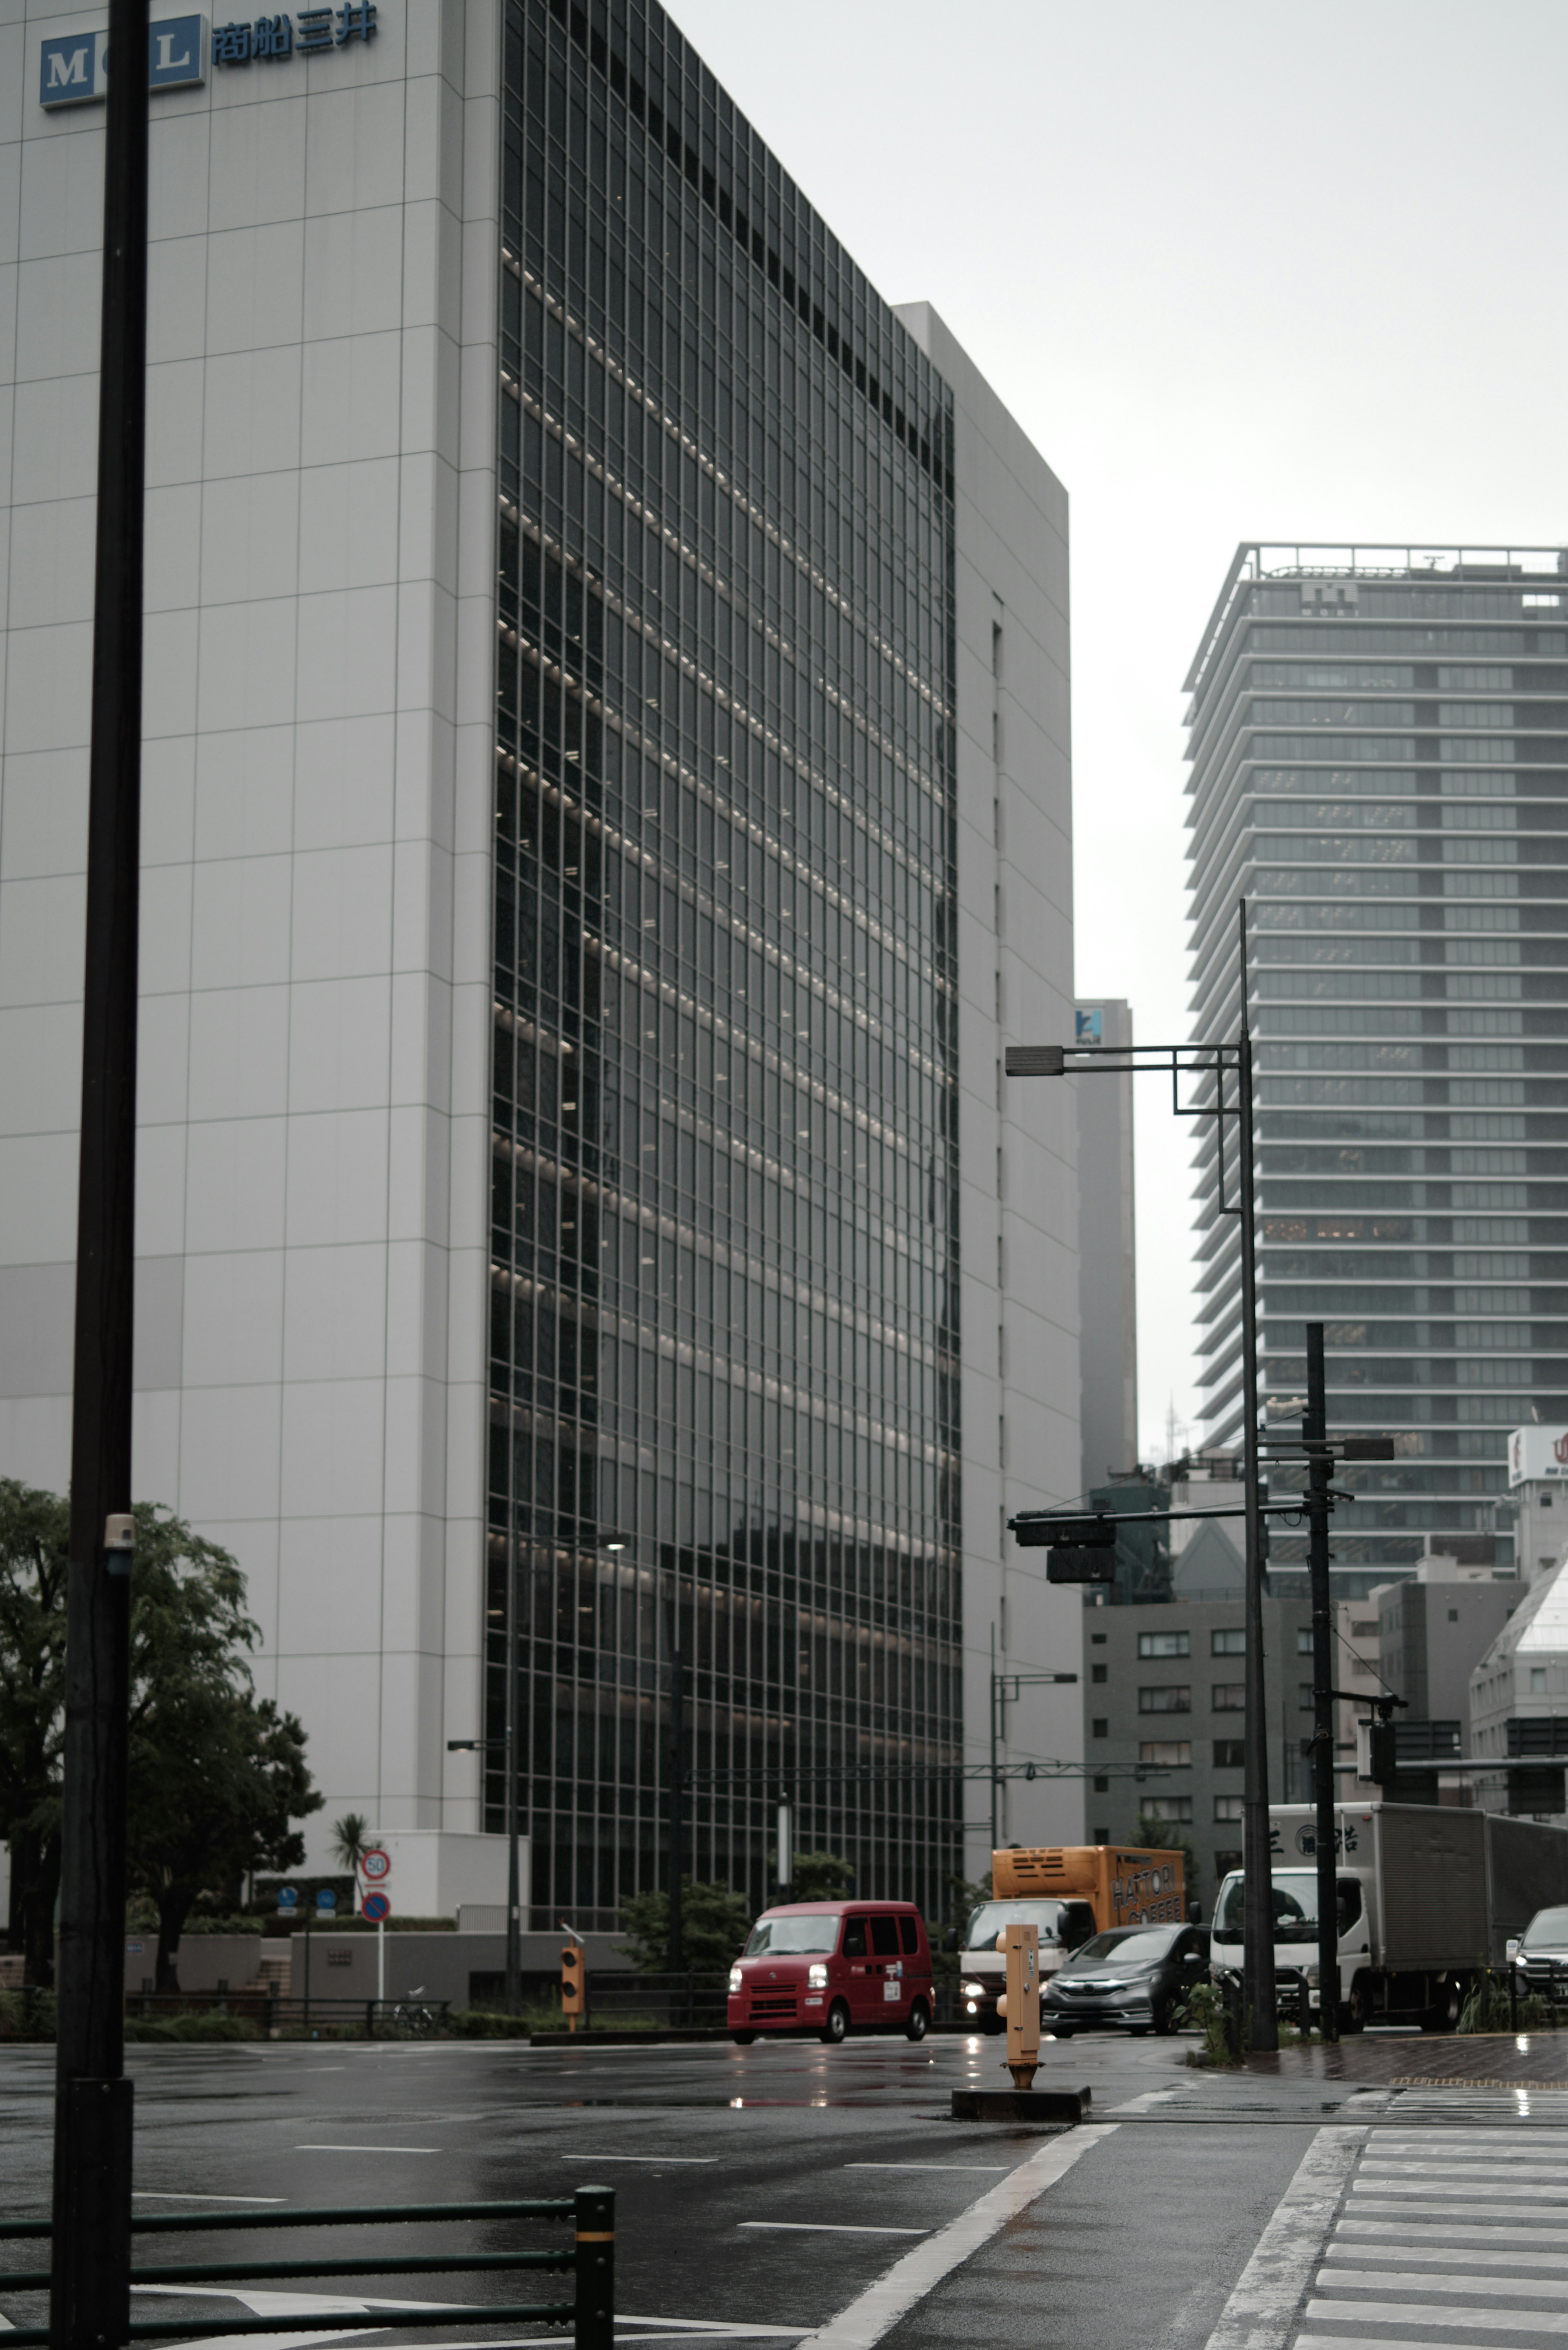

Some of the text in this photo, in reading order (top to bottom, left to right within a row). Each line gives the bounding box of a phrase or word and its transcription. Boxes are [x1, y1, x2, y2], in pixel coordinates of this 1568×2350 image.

[211, 0, 377, 66] 商船三井
[47, 33, 190, 88] ML
[1301, 608, 1359, 616] MORI
[368, 1858, 384, 1872] 50
[1112, 1862, 1175, 1911] HATTORI
[1128, 1895, 1181, 1925] COFFEE
